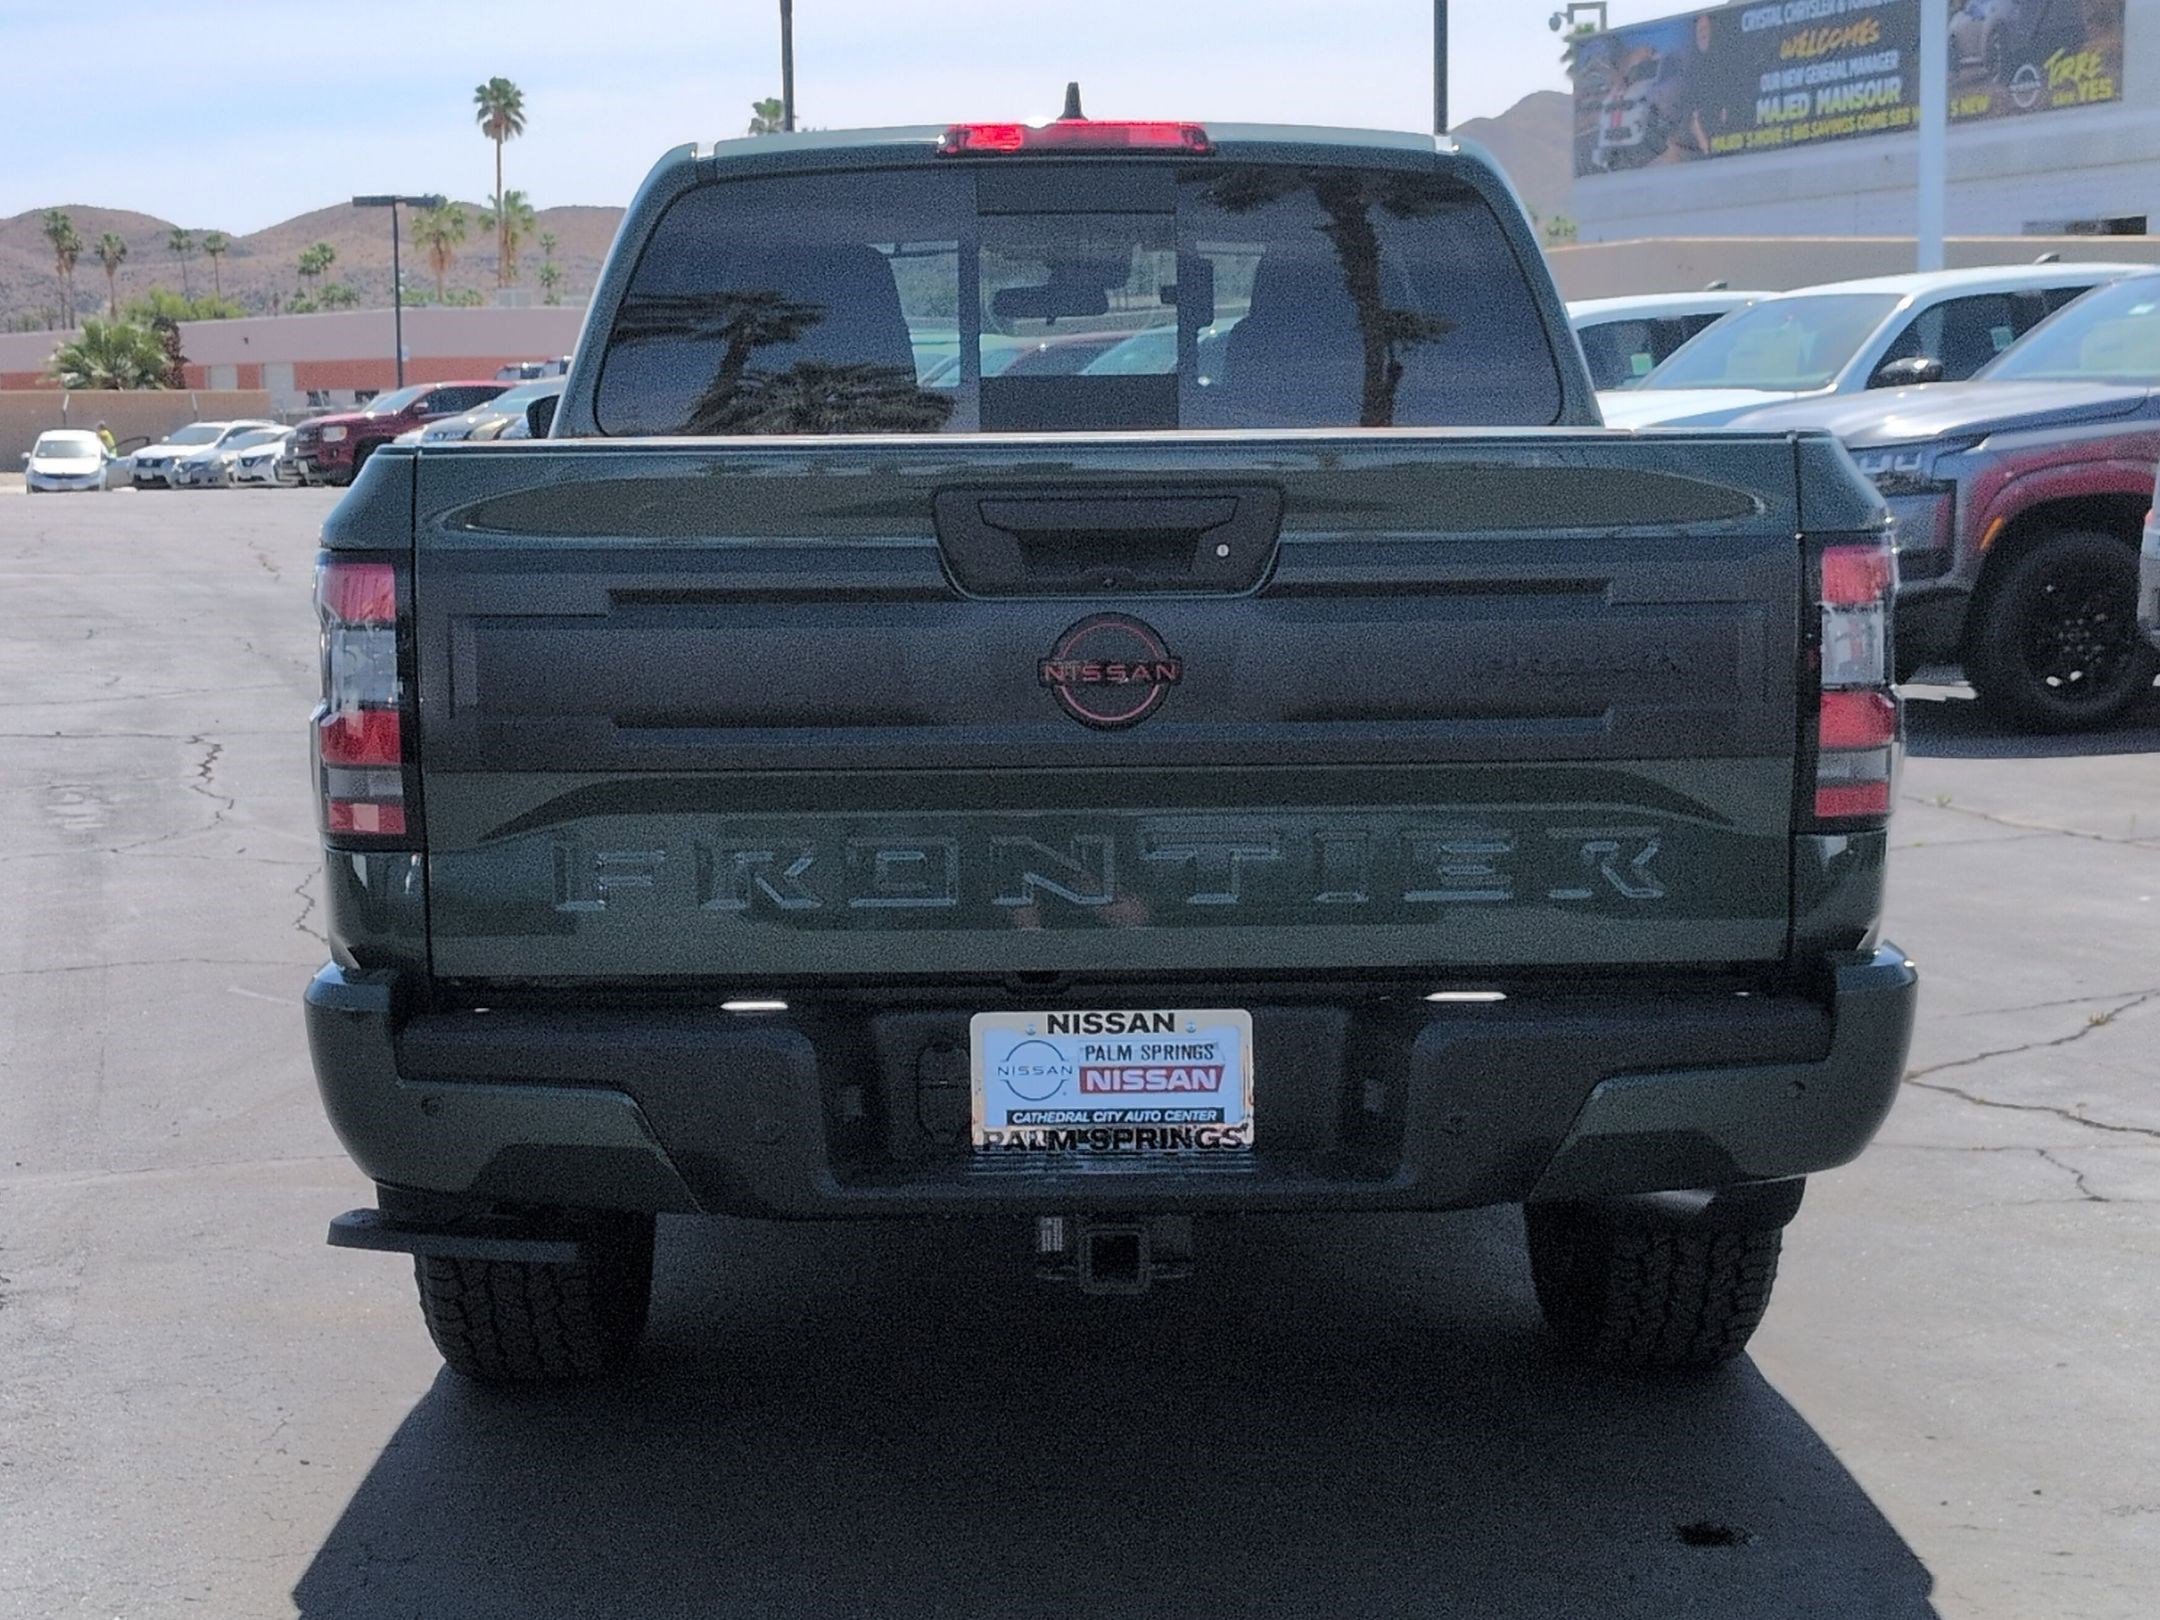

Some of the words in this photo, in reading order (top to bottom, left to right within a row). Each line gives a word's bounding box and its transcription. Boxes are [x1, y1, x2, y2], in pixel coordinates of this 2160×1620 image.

[1044, 664, 1176, 682] NISSAN
[551, 827, 1666, 910] FRONTIER
[1047, 1012, 1176, 1035] NISSAN
[1085, 1045, 1132, 1061] PALM
[1141, 1043, 1215, 1061] SPRINGS
[997, 1065, 1073, 1076] NISSAN
[1086, 1068, 1218, 1092] NISSAN
[1012, 1111, 1090, 1124] CATHEDRAL
[1093, 1111, 1123, 1123] CITY
[1124, 1111, 1162, 1123] AUTO
[1164, 1110, 1217, 1123] CENTER
[983, 1128, 1078, 1151] PALM
[1089, 1127, 1244, 1151] SPRINGS
